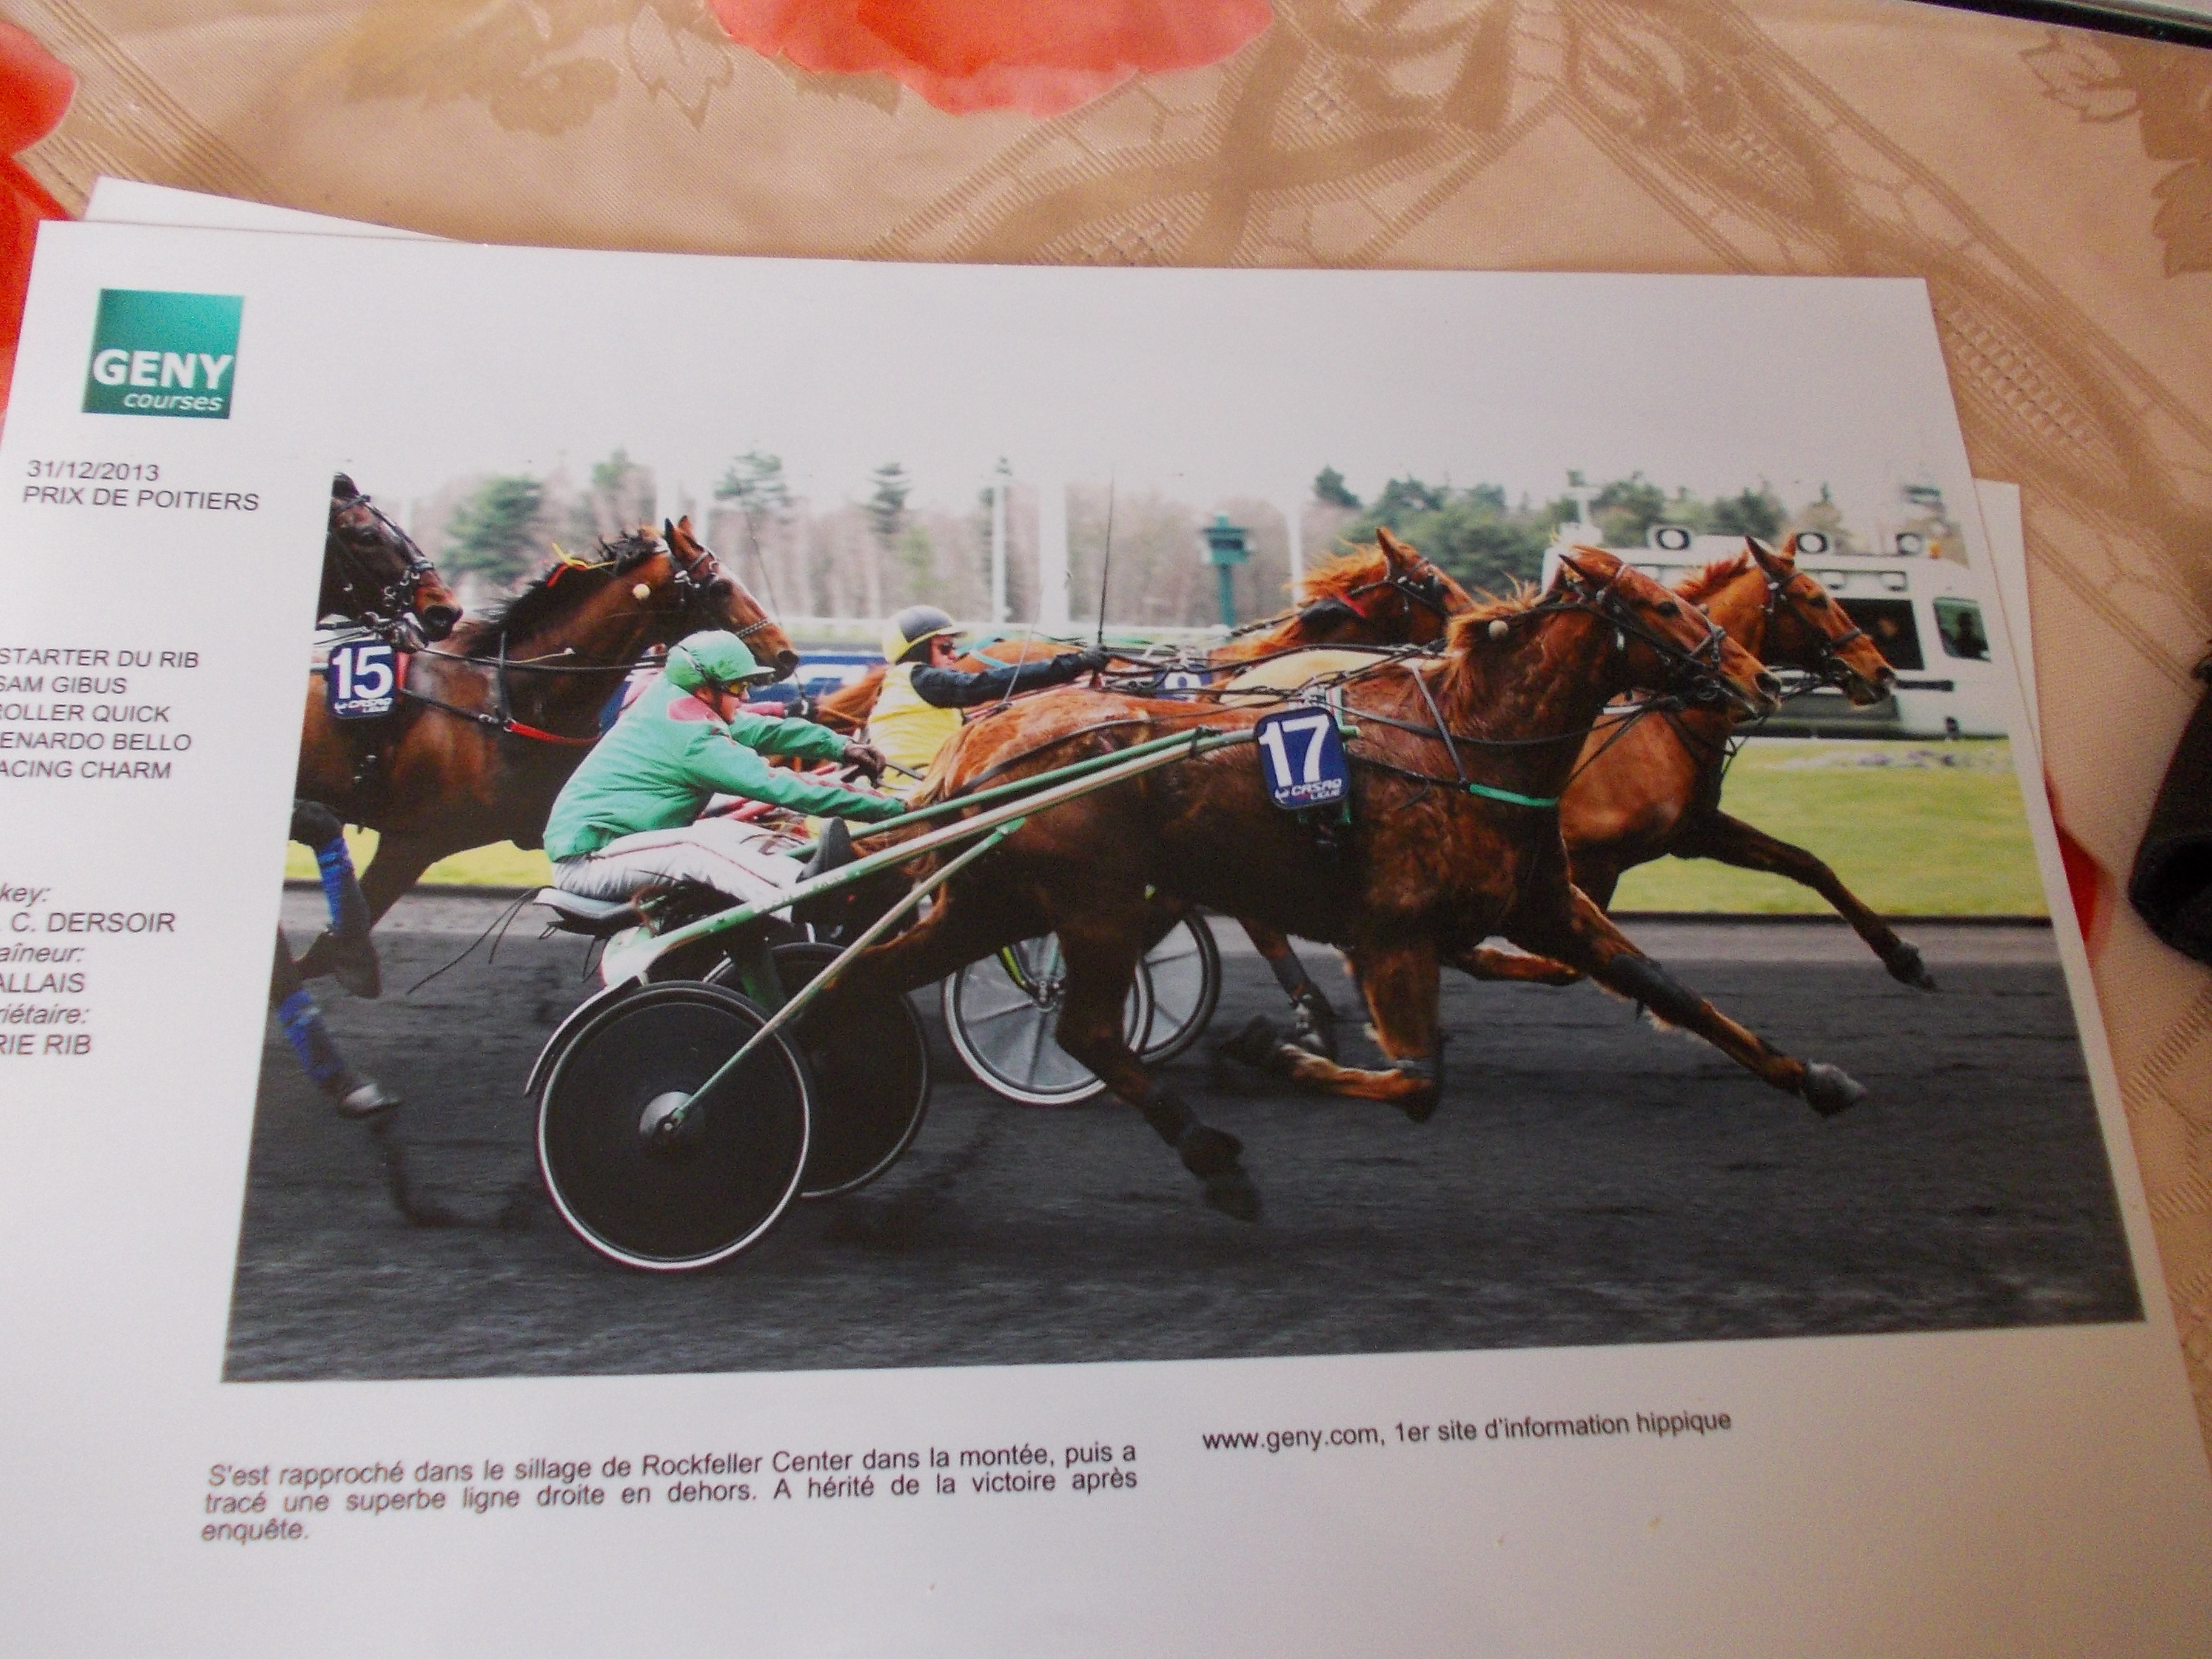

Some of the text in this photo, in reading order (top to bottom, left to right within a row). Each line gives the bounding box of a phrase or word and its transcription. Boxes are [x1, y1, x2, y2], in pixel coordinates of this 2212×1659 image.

[93, 349, 233, 389] GENY
[123, 391, 223, 411] courses
[27, 460, 159, 481] 31/12/2013
[23, 486, 259, 511] PRIX DE POITIERS
[0, 648, 199, 668] STARTER DU RIB
[333, 646, 393, 699] 15
[52, 676, 127, 694] GIBUS
[0, 703, 170, 723] OLLER QUICK
[113, 733, 192, 751] BELLO
[1258, 714, 1329, 788] 17
[81, 761, 172, 779] CHARM
[12, 912, 176, 933] C. DERSOIR
[44, 1034, 92, 1055] RIB
[1202, 1410, 1731, 1454] www.geny.com, 1er site d'information hippique
[209, 1441, 1136, 1489] S'est rapproché dans le sillage de Rockfeller Center dans la montée, puis a
[206, 1467, 1138, 1515] tracé une superbe ligne droite en dehors. A hérité de la victoire après
[201, 1518, 308, 1545] enquête.
